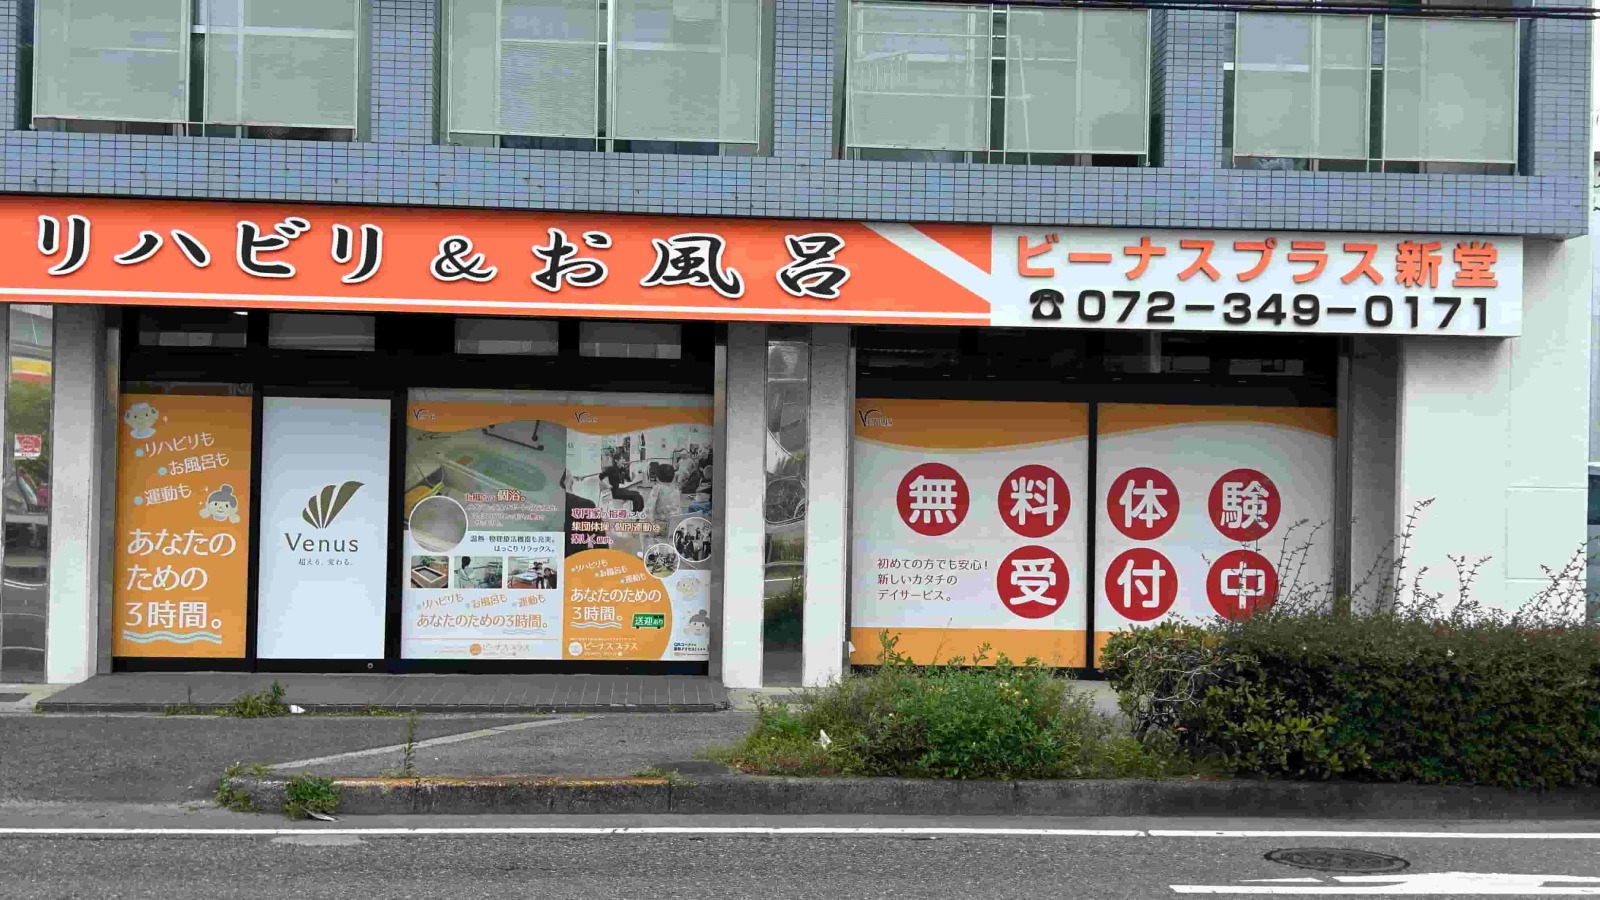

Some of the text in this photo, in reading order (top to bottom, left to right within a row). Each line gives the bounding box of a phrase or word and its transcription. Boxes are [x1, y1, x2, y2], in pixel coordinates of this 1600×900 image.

[36, 213, 851, 300] リハビリ & お風呂
[1016, 233, 1500, 290] ビーナスプラス新堂
[1076, 289, 1489, 331] 072-349-0171
[143, 431, 215, 457] リハビリも
[168, 452, 230, 476] お風呂も
[145, 483, 192, 506] 運動も
[127, 528, 237, 557] あなたの
[284, 532, 359, 553] Venus
[126, 564, 209, 592] ための
[877, 573, 958, 586] 新しいカタチの
[570, 587, 662, 603] あなたのための
[878, 589, 952, 602] デイサービス。
[125, 600, 223, 630] 3時間。
[416, 613, 548, 629] あなたのための3時間。
[572, 606, 623, 622] 3時間。
